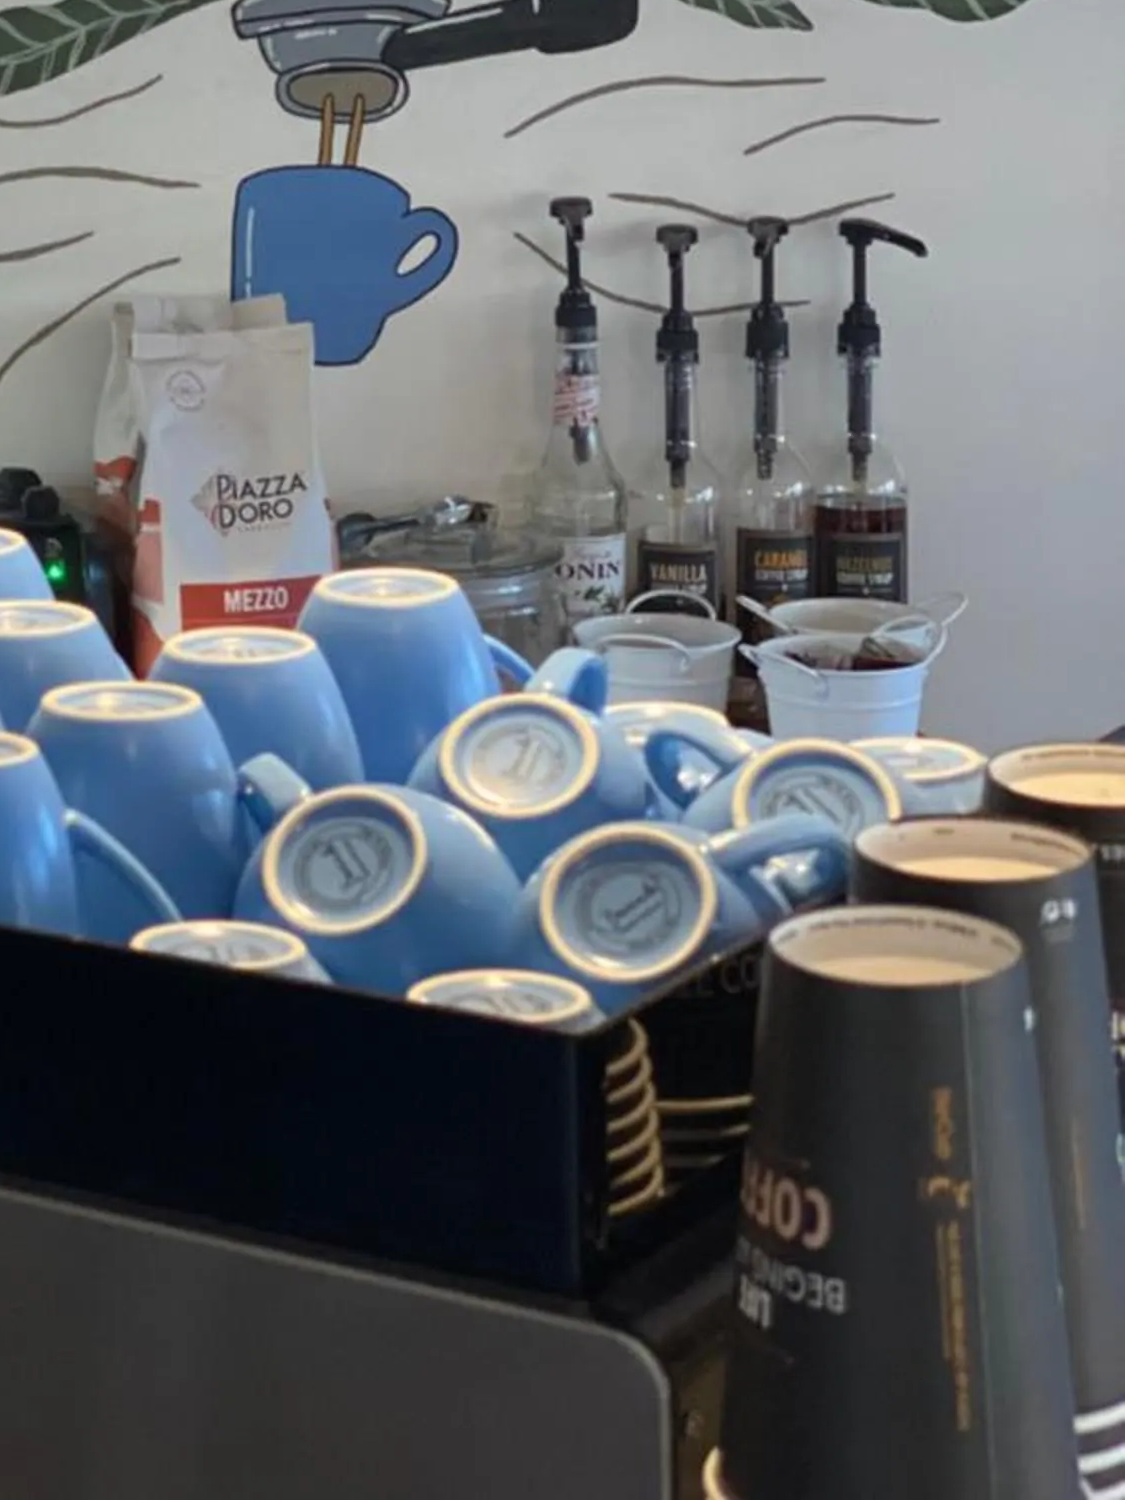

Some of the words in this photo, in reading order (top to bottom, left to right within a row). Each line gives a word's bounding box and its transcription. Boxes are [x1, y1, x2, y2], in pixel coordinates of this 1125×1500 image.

[217, 472, 308, 501] PIAZZA
[219, 498, 293, 529] DORO
[555, 560, 620, 581] ONIN
[650, 562, 707, 582] VANILLA
[224, 586, 289, 613] MEZZO
